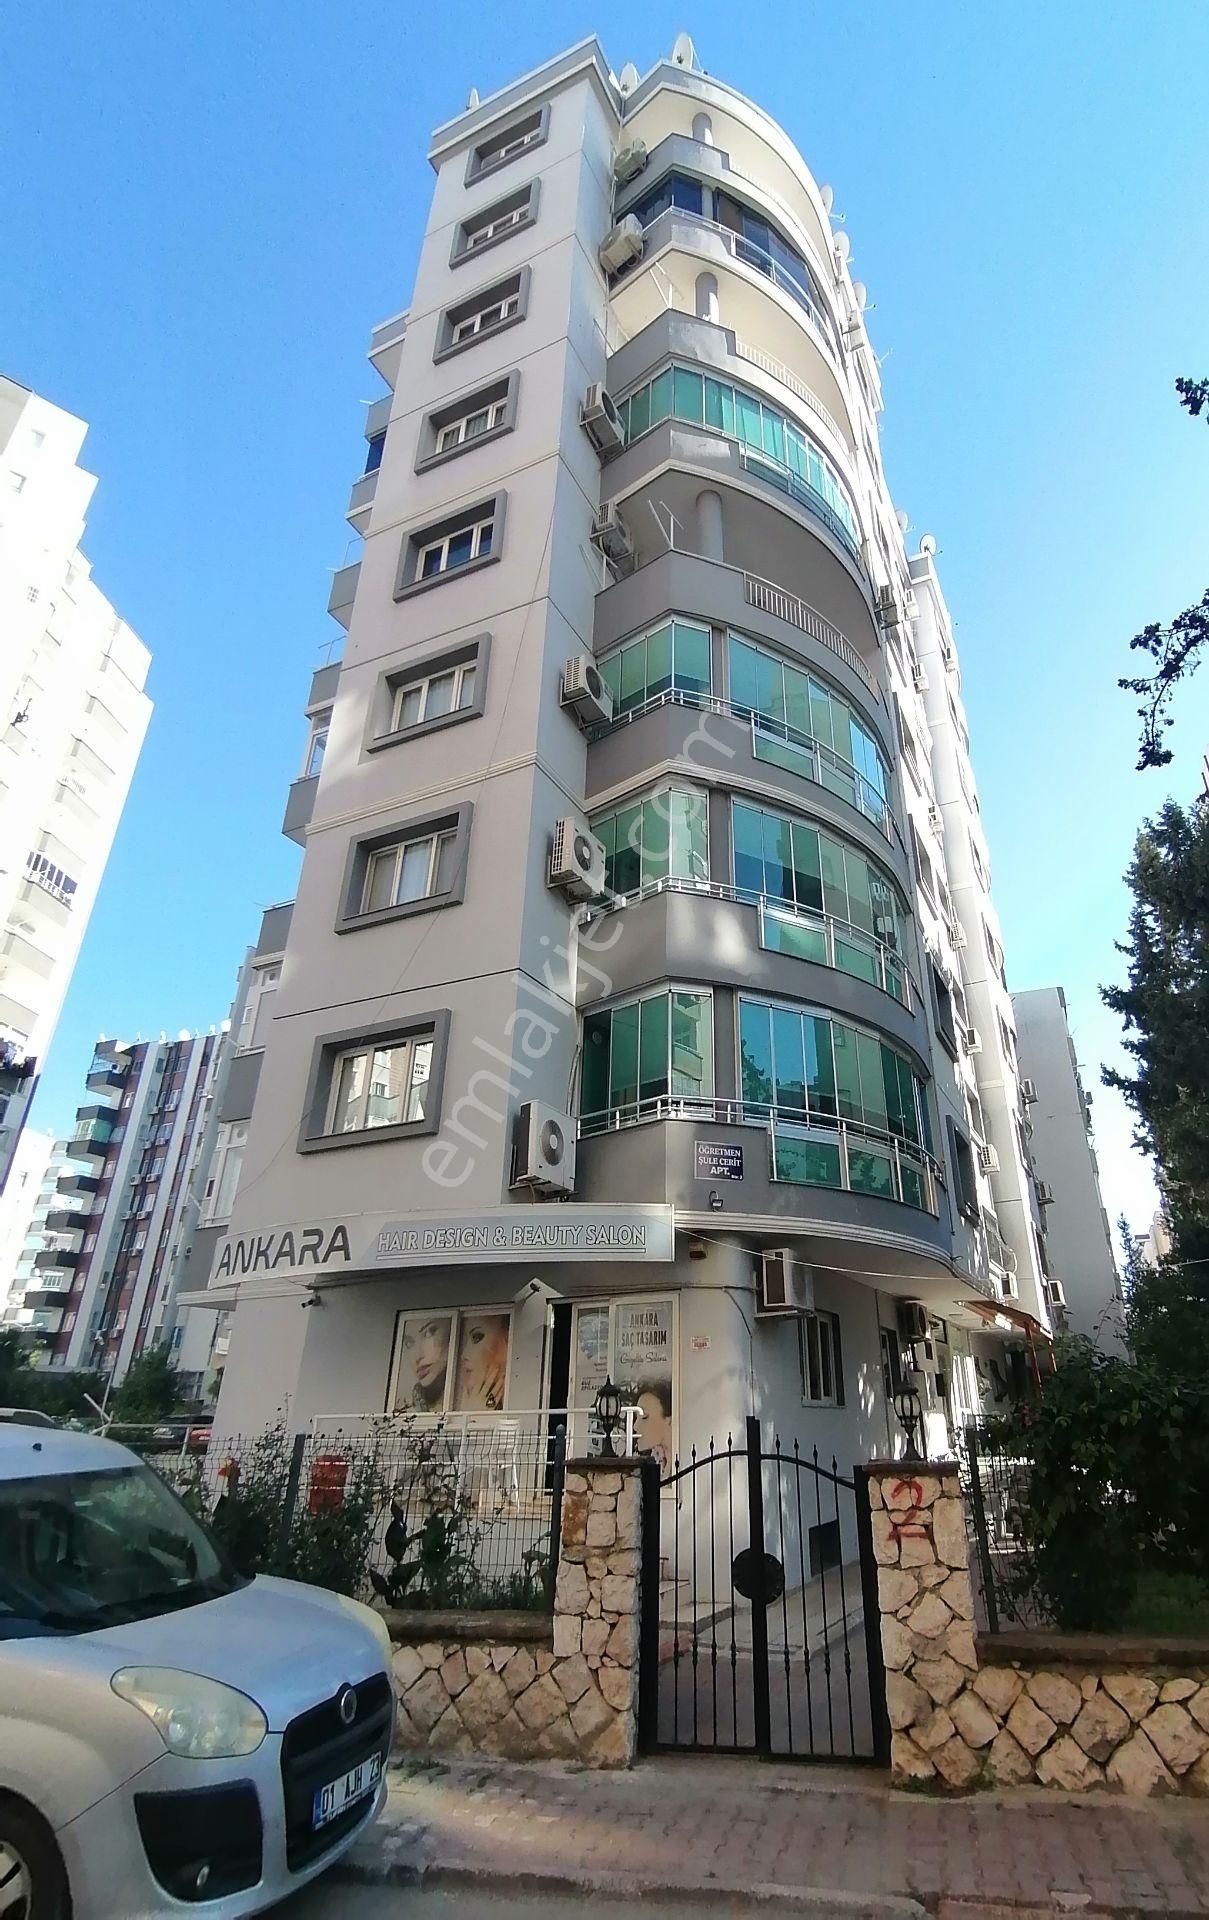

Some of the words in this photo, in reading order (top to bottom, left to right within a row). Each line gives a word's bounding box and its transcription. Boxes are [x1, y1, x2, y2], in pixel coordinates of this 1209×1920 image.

[698, 1144, 741, 1157] ÖĞRETMEN
[698, 1156, 719, 1166] ŞULE
[719, 1157, 742, 1167] CERİT
[710, 1166, 730, 1176] APT.
[378, 1230, 419, 1252] HAIR
[423, 1227, 489, 1249] DESIGN
[492, 1226, 507, 1247] &
[511, 1225, 583, 1246] BEAUTY
[585, 1225, 646, 1246] SALON
[214, 1224, 352, 1280] ANKARA
[630, 1312, 659, 1328] ANKARA
[621, 1332, 635, 1348] SAÇ
[636, 1330, 667, 1346] TASARIM
[321, 1783, 335, 1816] 01
[344, 1765, 363, 1801] AJH
[369, 1754, 380, 1782] 23
